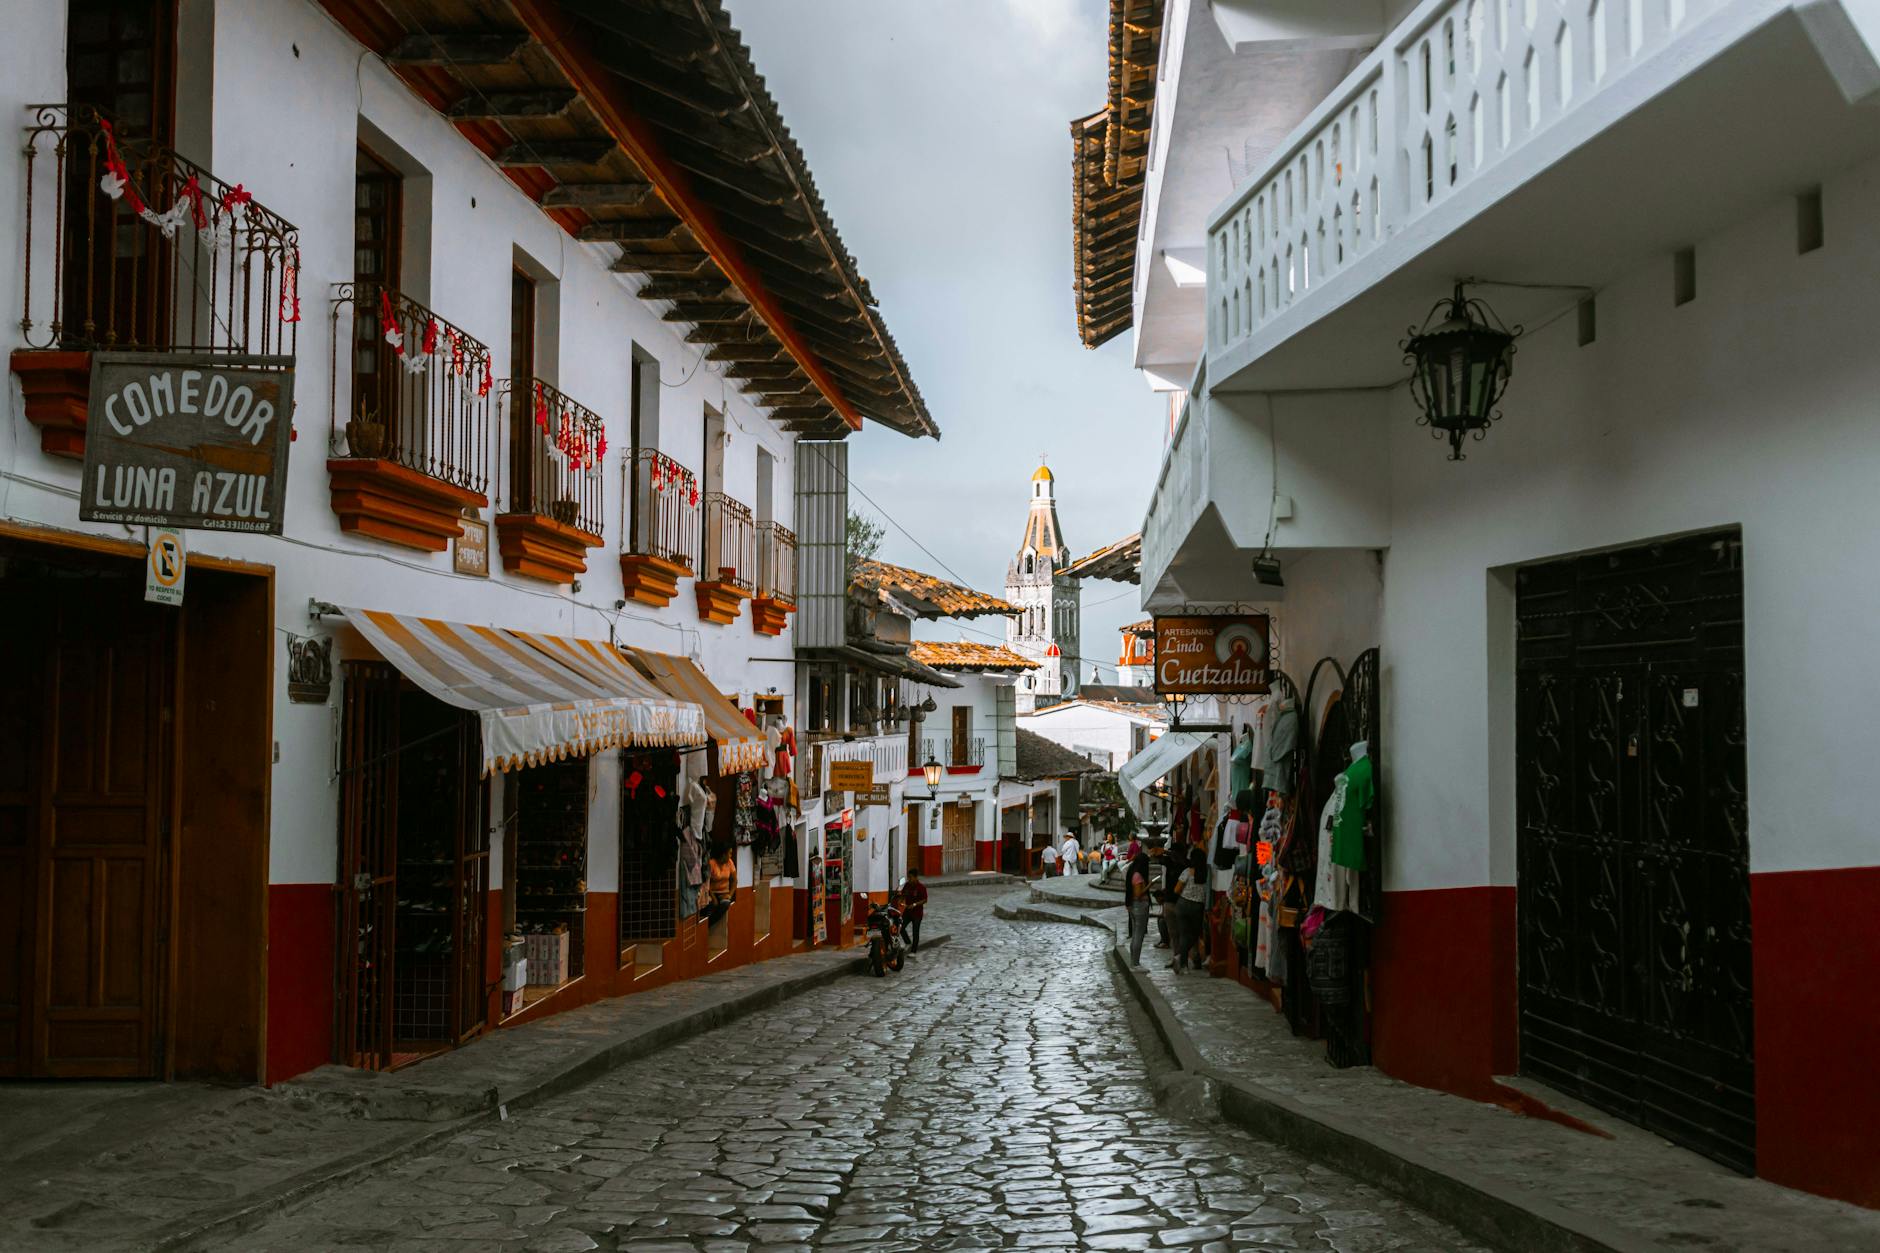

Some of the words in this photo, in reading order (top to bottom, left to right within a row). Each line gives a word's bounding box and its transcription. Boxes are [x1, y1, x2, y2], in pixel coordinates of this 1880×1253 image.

[105, 370, 274, 446] COMEDOR
[96, 464, 177, 511] LUNA
[191, 471, 270, 519] AZUL
[1161, 637, 1204, 655] Lindo
[1160, 659, 1266, 686] Cuetzalan
